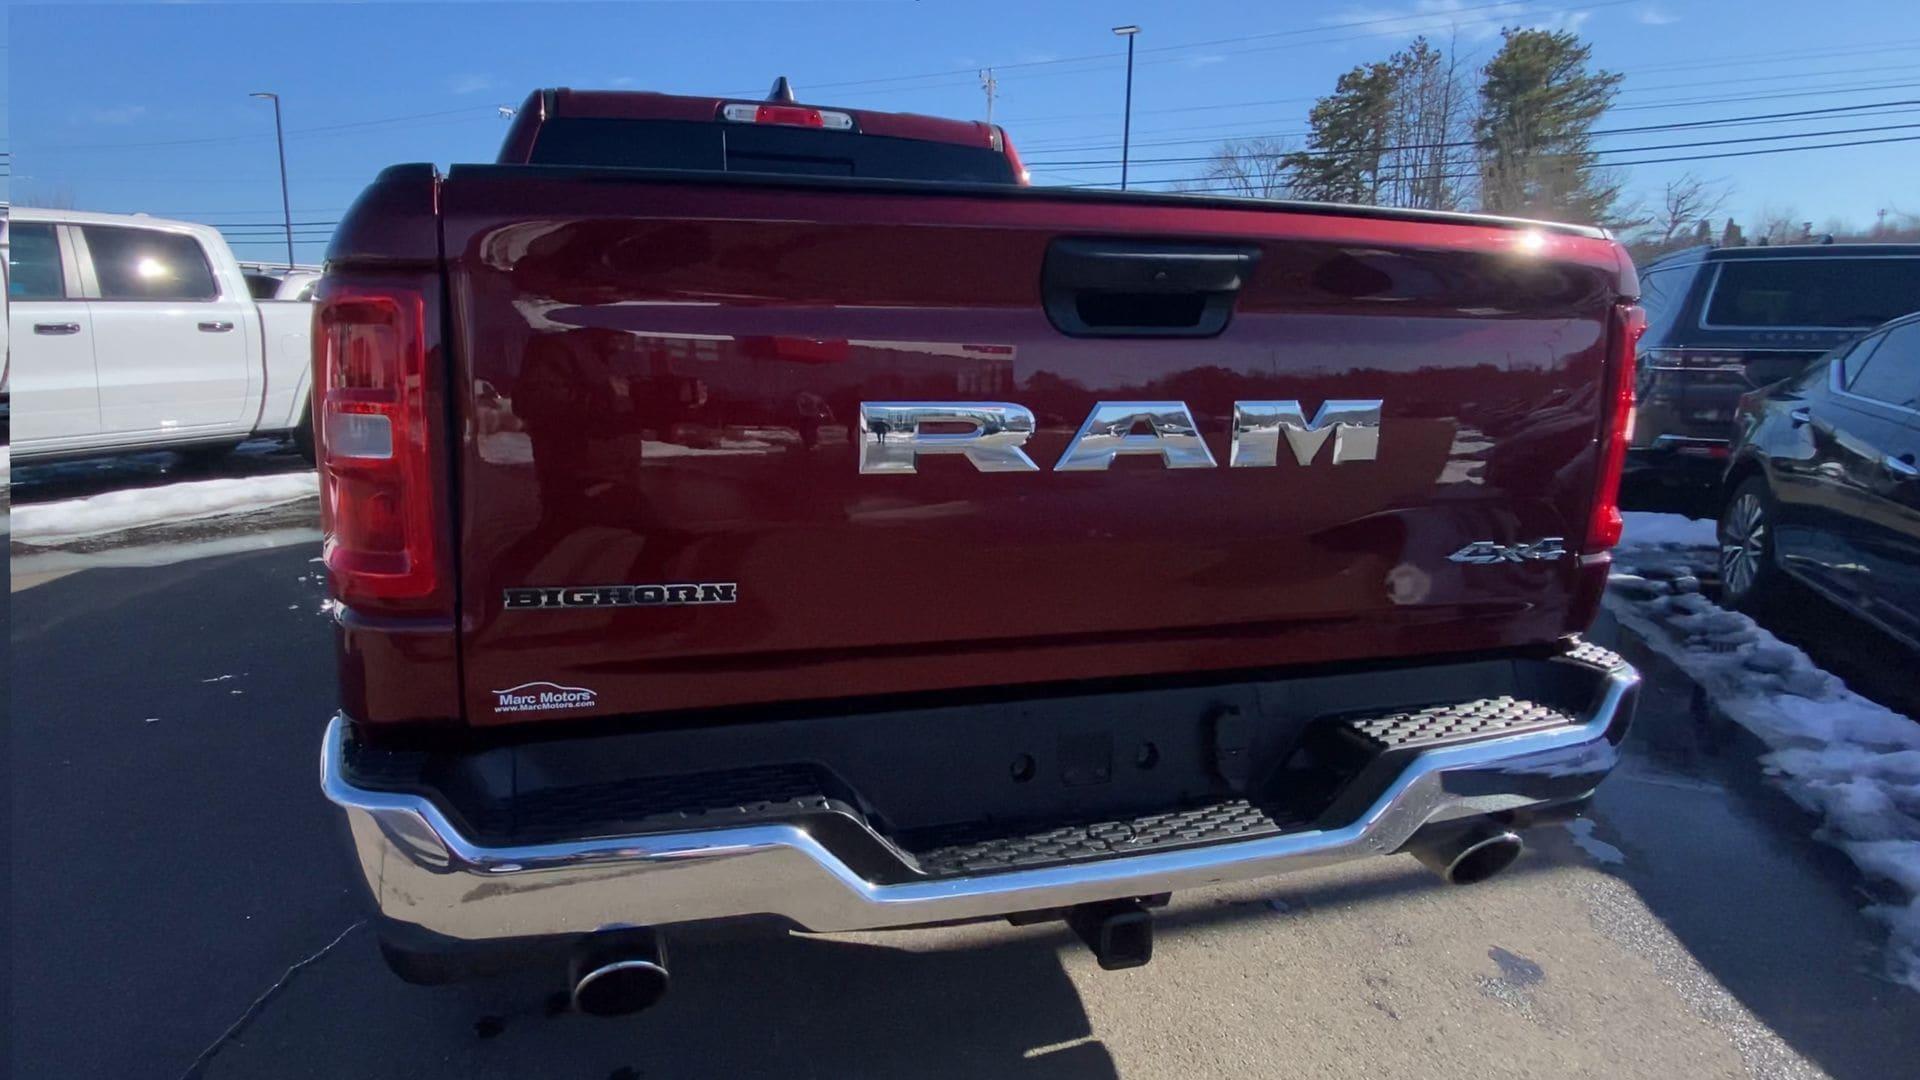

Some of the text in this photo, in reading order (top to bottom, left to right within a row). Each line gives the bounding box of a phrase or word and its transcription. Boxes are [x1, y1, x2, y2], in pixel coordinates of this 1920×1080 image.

[859, 400, 1384, 474] RAM
[504, 583, 737, 609] BIGHORN
[494, 701, 596, 713] www.MarcMotors.com
[499, 691, 591, 706] Marc Motors
